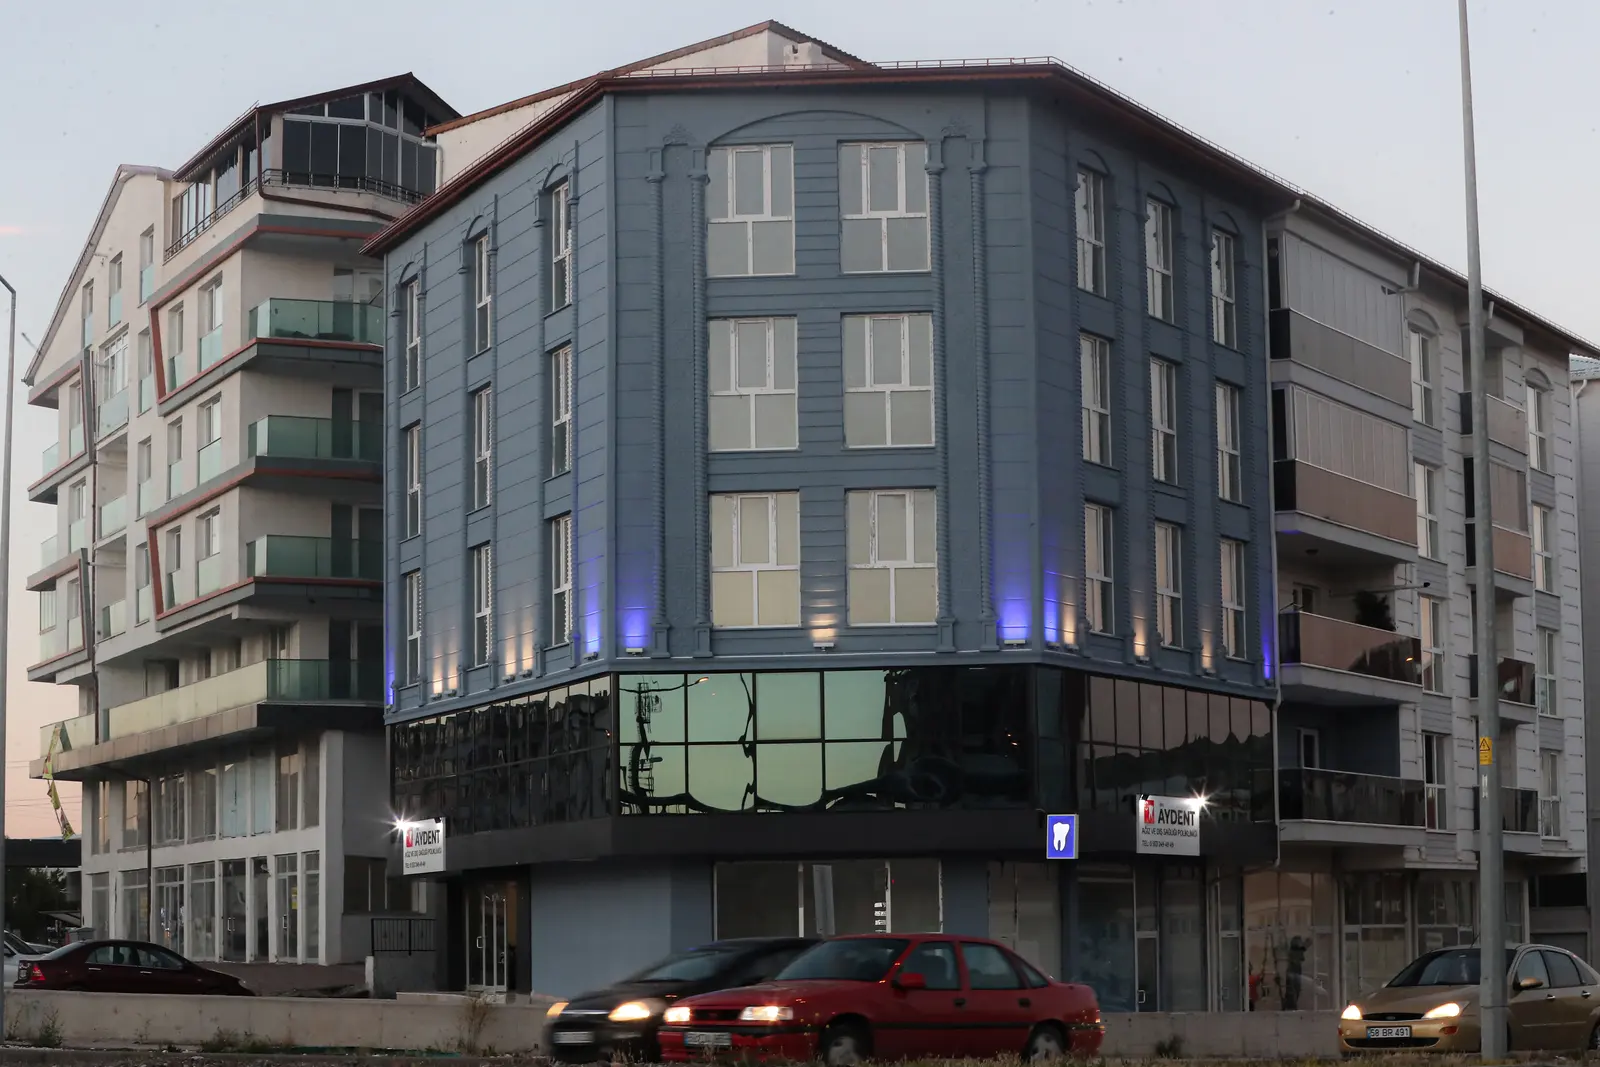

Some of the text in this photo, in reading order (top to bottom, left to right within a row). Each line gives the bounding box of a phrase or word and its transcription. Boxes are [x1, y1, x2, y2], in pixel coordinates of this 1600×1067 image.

[1158, 808, 1195, 826] AYDENT
[415, 829, 440, 847] AYDENT
[1382, 1029, 1393, 1037] BR
[1395, 1028, 1409, 1037] 491
